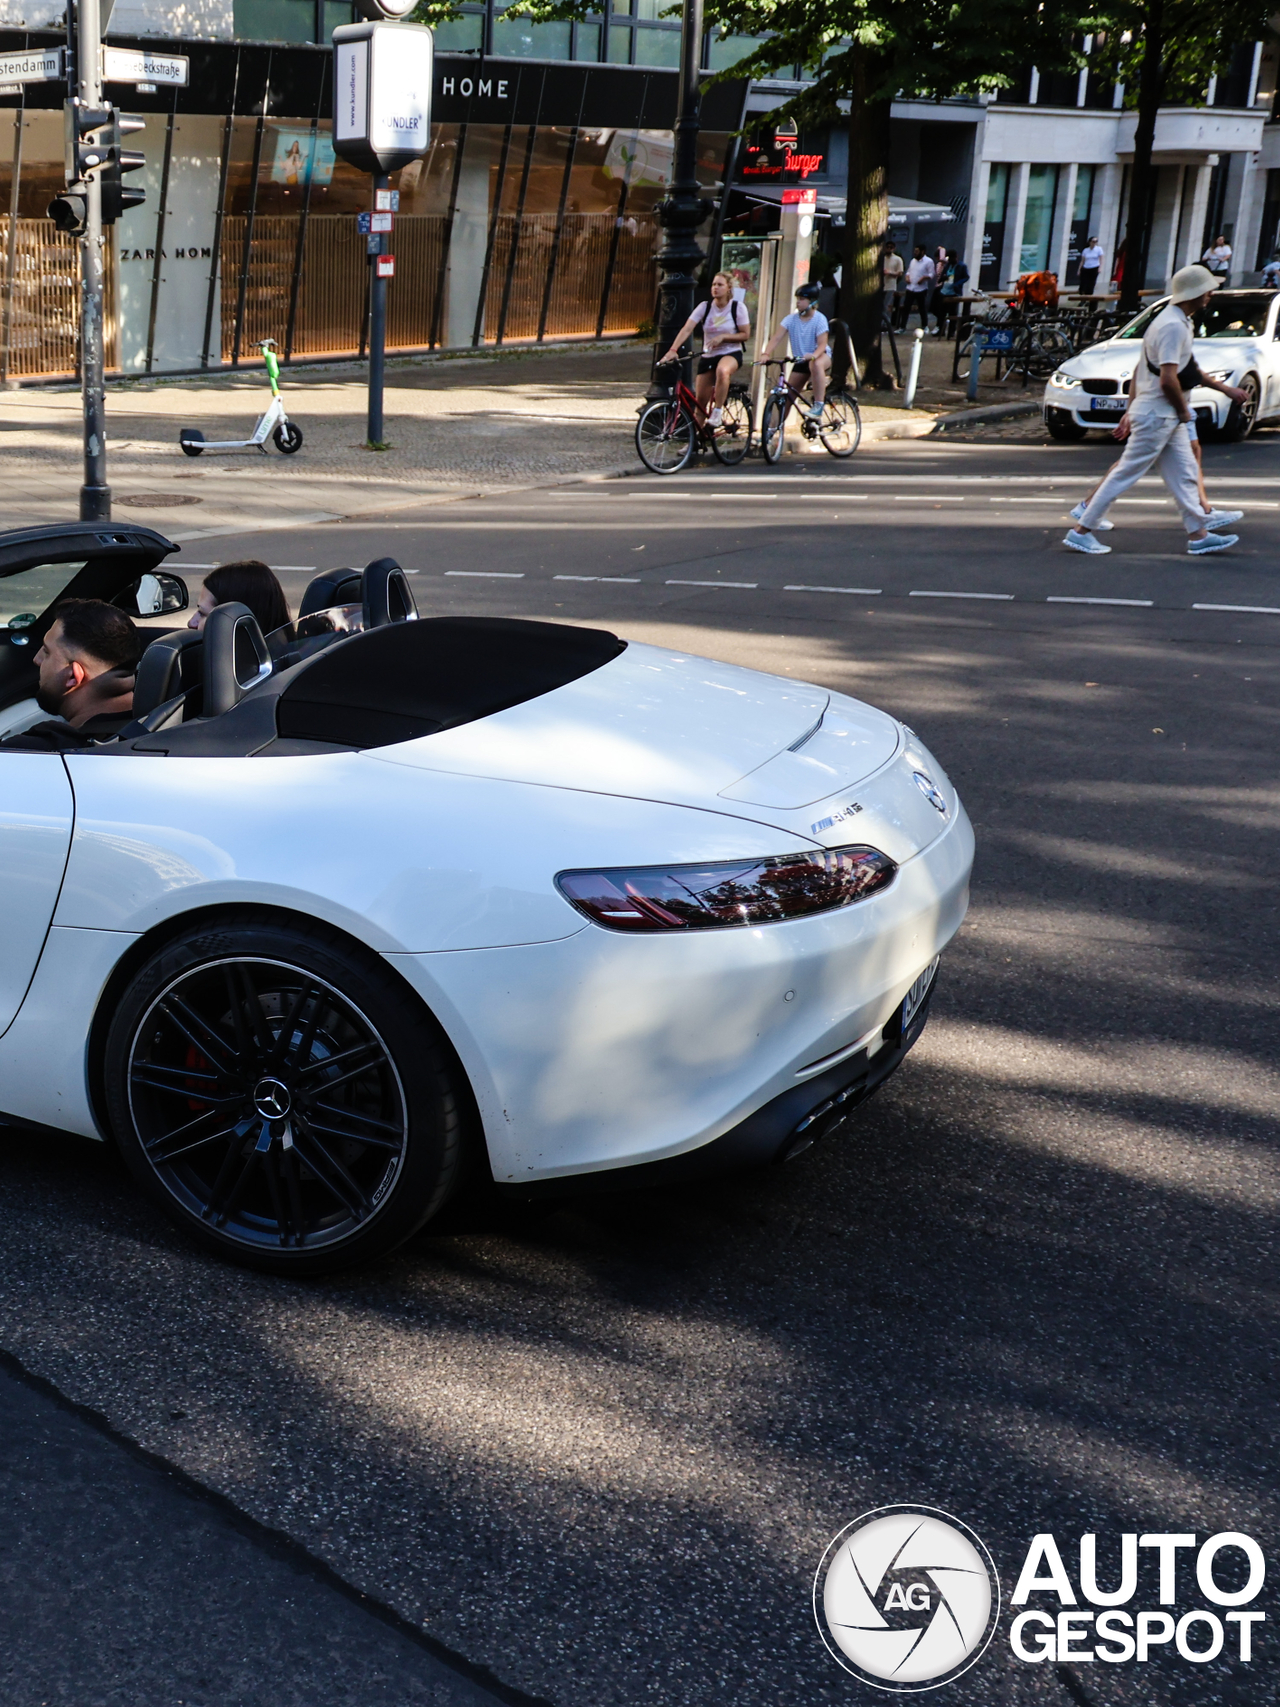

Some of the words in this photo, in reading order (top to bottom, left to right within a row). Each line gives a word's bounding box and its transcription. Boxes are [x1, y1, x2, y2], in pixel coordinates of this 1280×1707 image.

[112, 57, 180, 79] sebeckstraße
[442, 76, 509, 98] HOME
[382, 116, 419, 130] UNDLER
[175, 247, 211, 259] HOM
